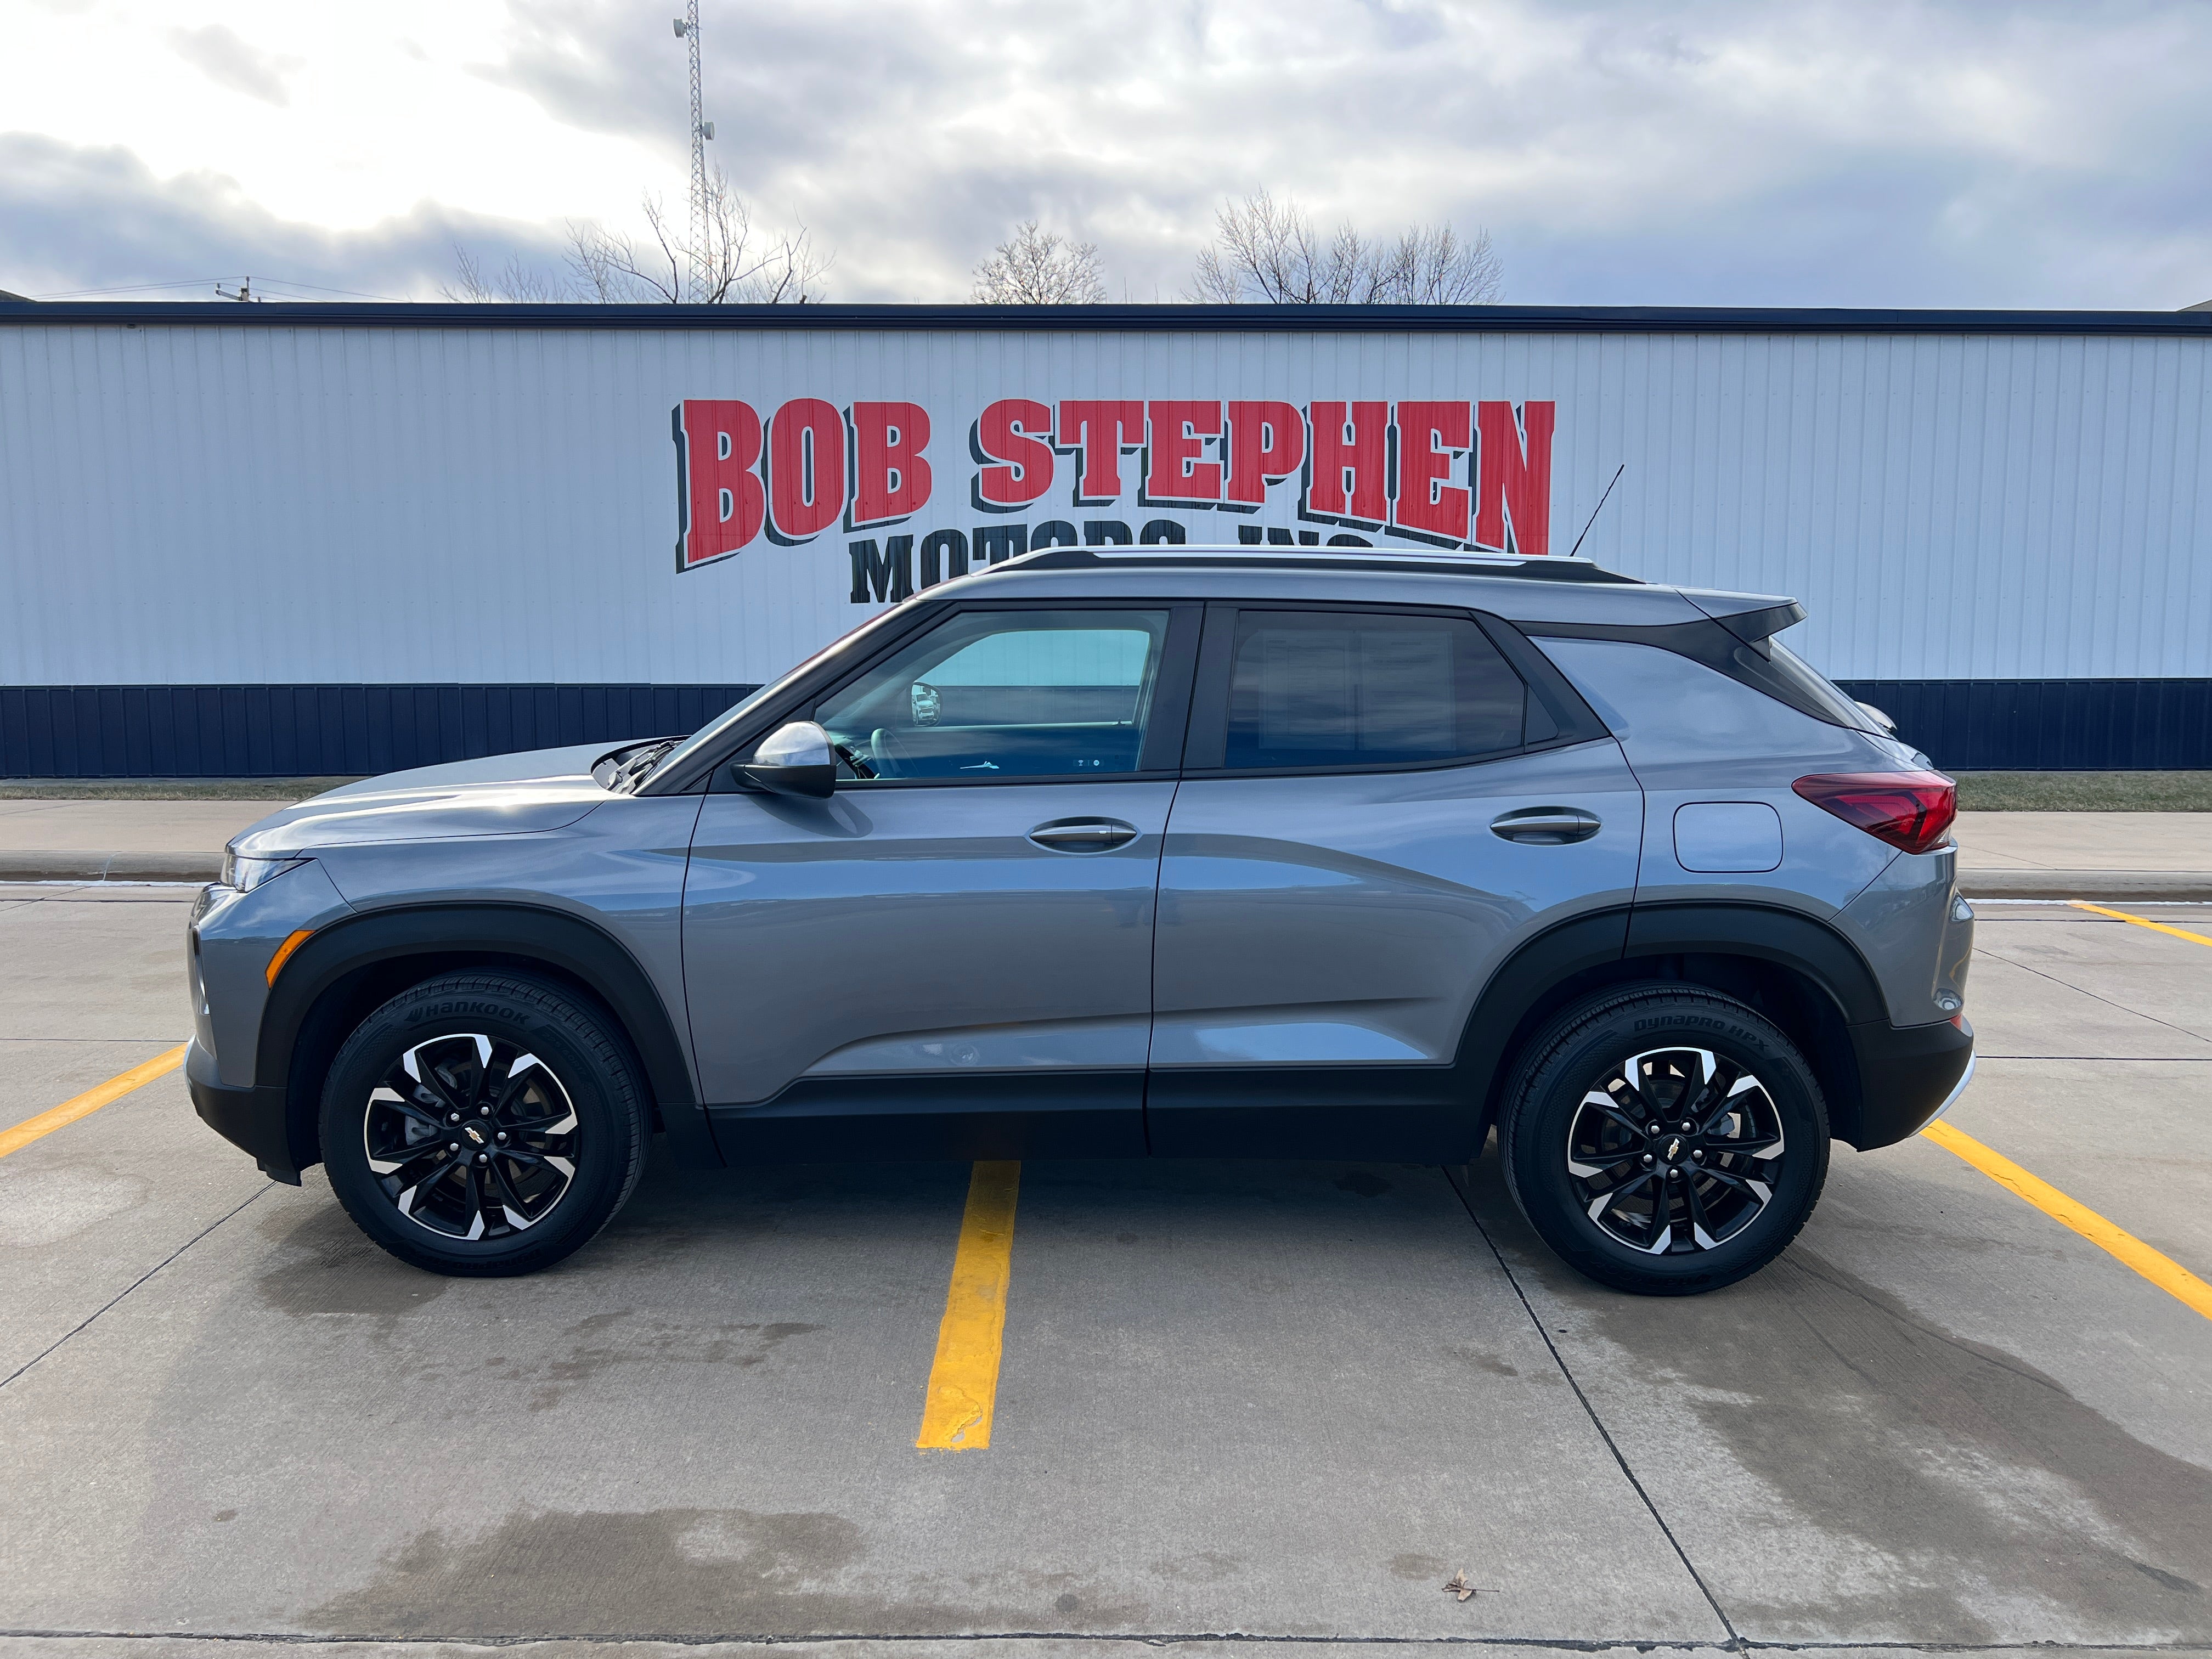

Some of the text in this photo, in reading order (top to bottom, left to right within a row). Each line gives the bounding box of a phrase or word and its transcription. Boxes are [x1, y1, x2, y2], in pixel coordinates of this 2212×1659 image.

[672, 398, 1556, 574] BOB STEPHEN
[1728, 1025, 1770, 1051] HPX
